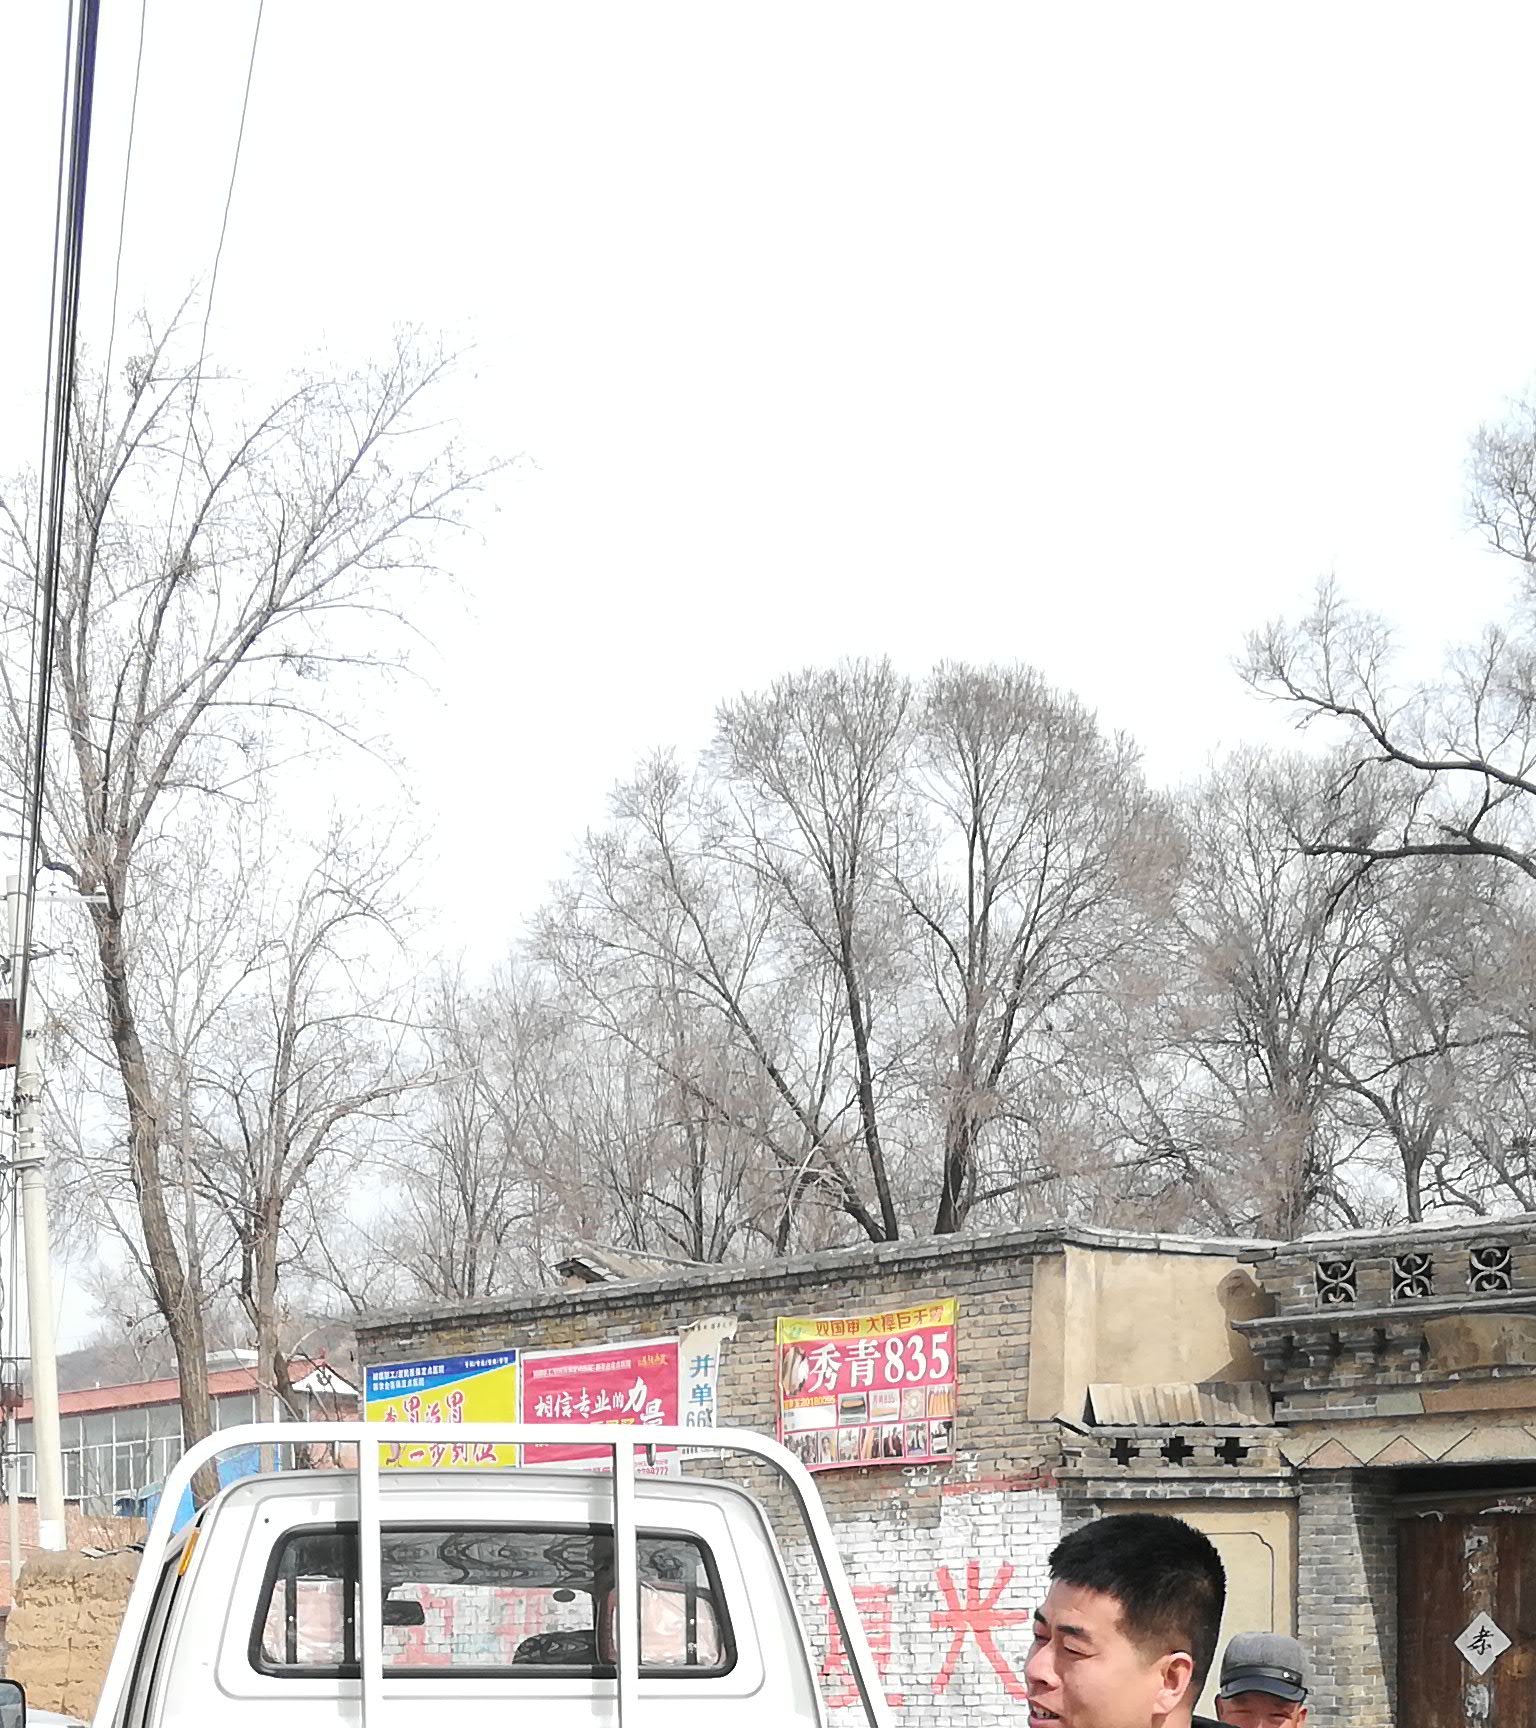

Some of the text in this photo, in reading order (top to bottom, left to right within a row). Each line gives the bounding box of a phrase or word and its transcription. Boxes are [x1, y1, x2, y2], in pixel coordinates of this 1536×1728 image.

[808, 1331, 950, 1393] 秀青835
[534, 1376, 665, 1425] 相信专业的力量
